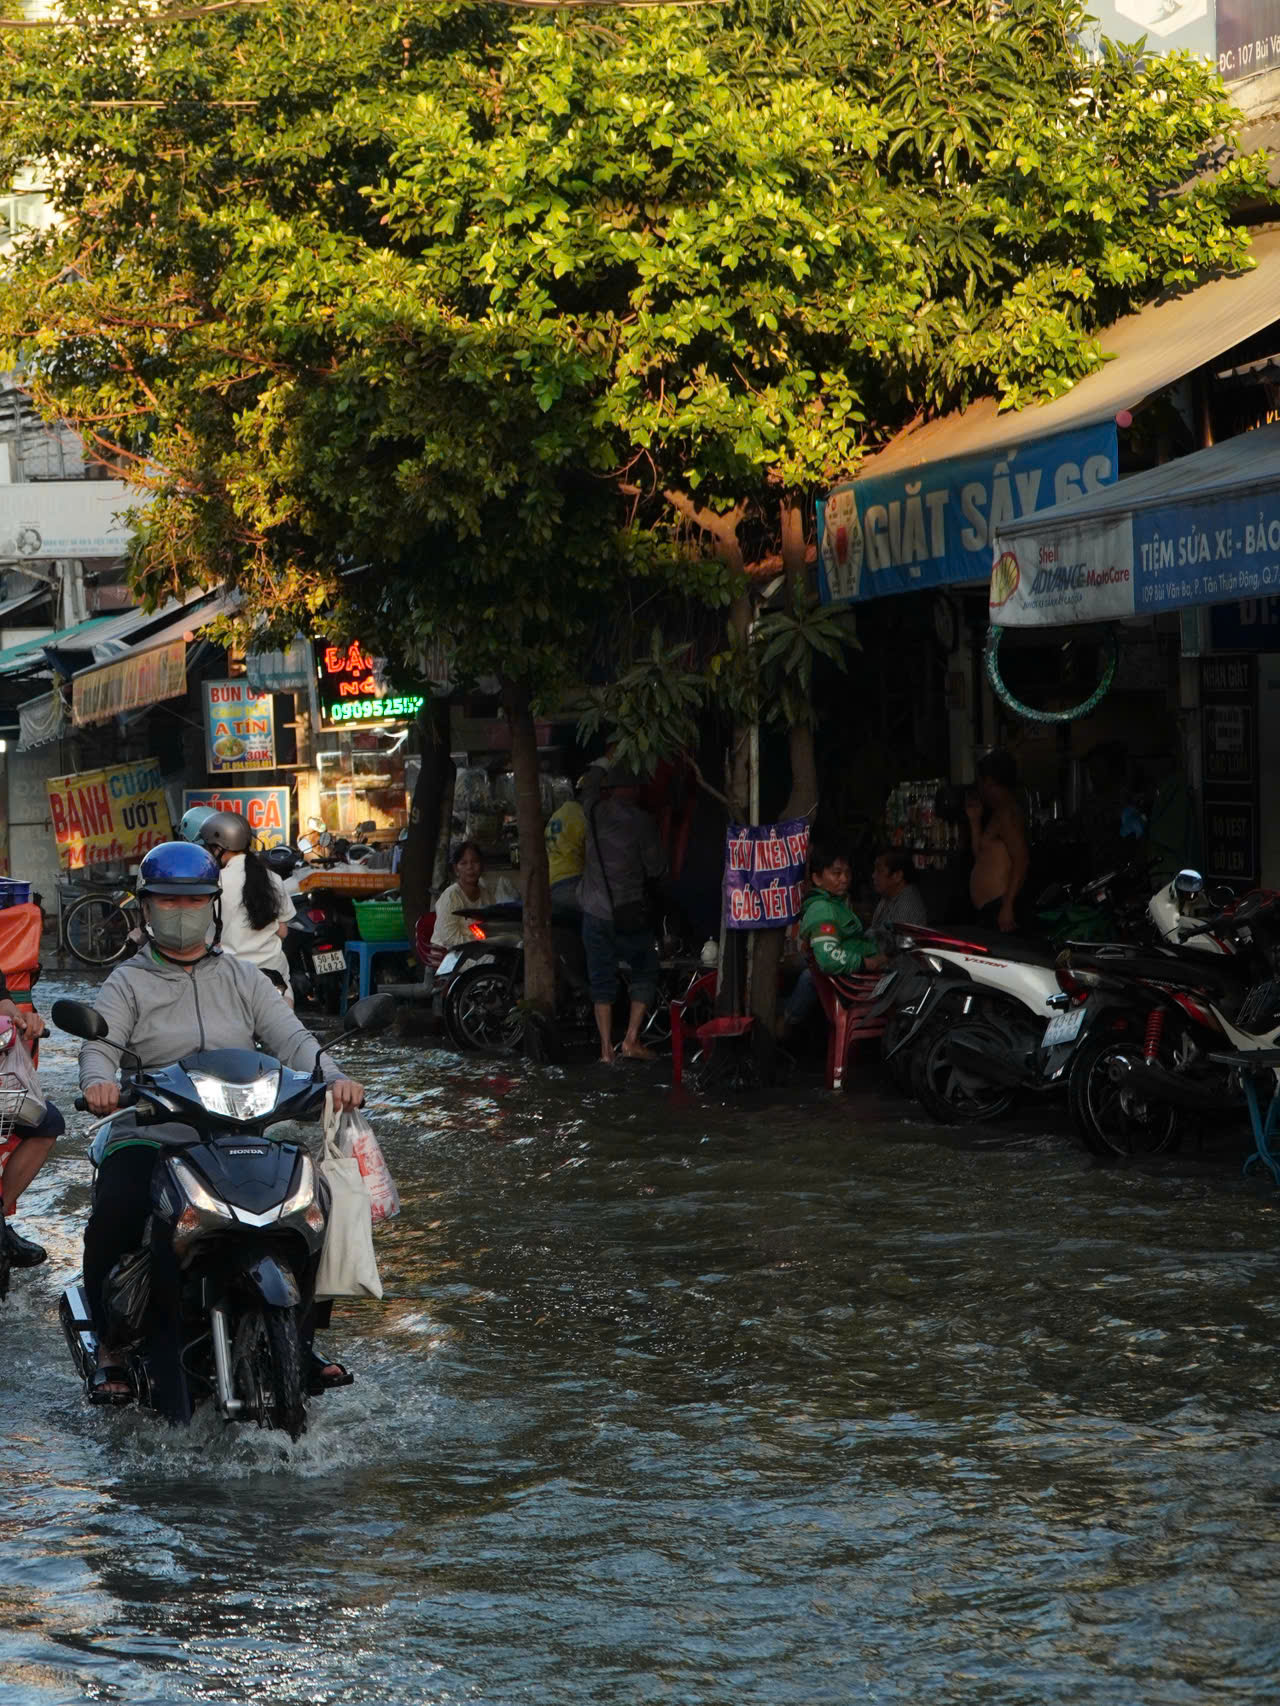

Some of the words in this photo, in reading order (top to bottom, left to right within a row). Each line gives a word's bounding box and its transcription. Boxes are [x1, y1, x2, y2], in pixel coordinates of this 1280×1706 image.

[1238, 43, 1253, 65] 107
[1255, 36, 1268, 59] Bùi
[1038, 544, 1059, 565] Shell
[1179, 525, 1211, 567] SỬA
[1215, 528, 1233, 560] XE
[1029, 563, 1087, 596] ADVANCE
[210, 683, 242, 703] BÚN
[216, 722, 230, 736] A
[233, 718, 267, 735] TÍN
[247, 749, 270, 761] 30K
[49, 777, 114, 843] BÁNH
[247, 793, 281, 828] CÁ
[731, 884, 761, 921] CÁC
[963, 956, 1008, 969] VISION
